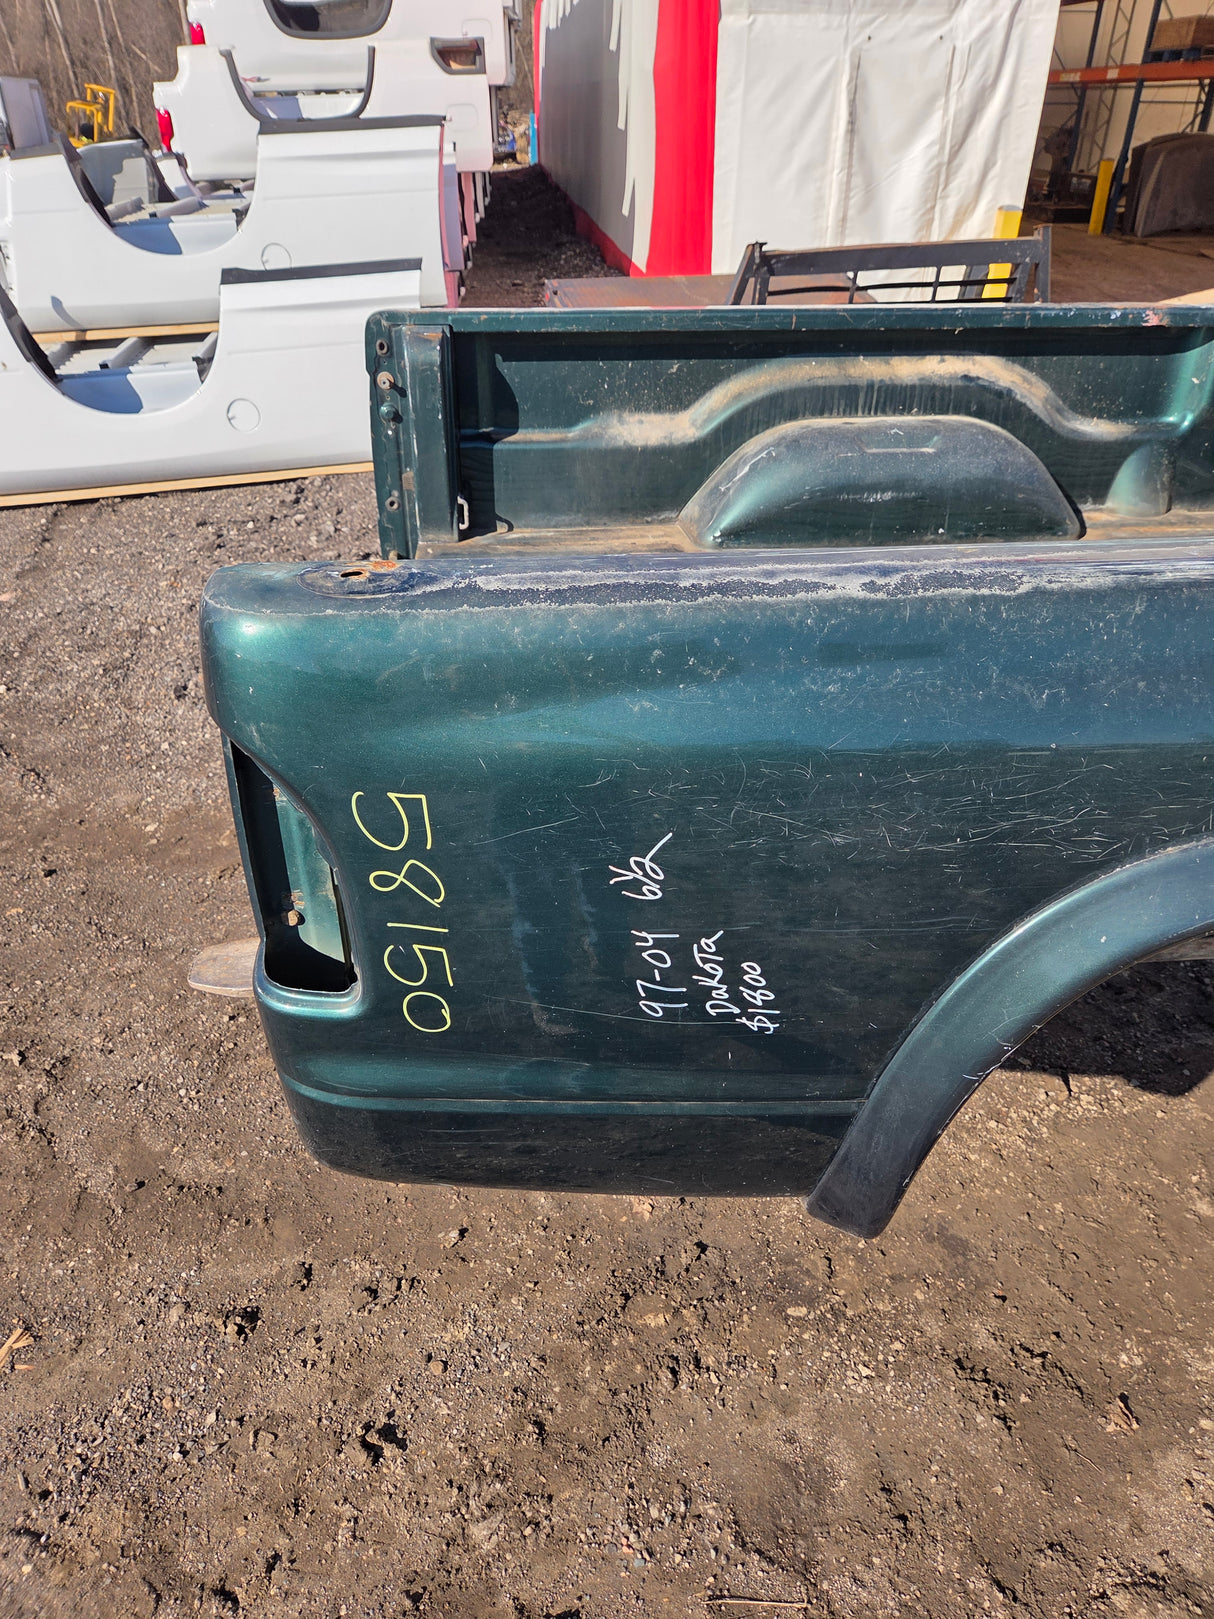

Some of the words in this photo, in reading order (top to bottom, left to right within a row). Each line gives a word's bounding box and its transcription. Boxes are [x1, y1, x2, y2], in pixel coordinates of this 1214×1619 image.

[351, 791, 454, 1033] 58150
[630, 929, 689, 1018] 97-04
[735, 961, 782, 1035] $1800
